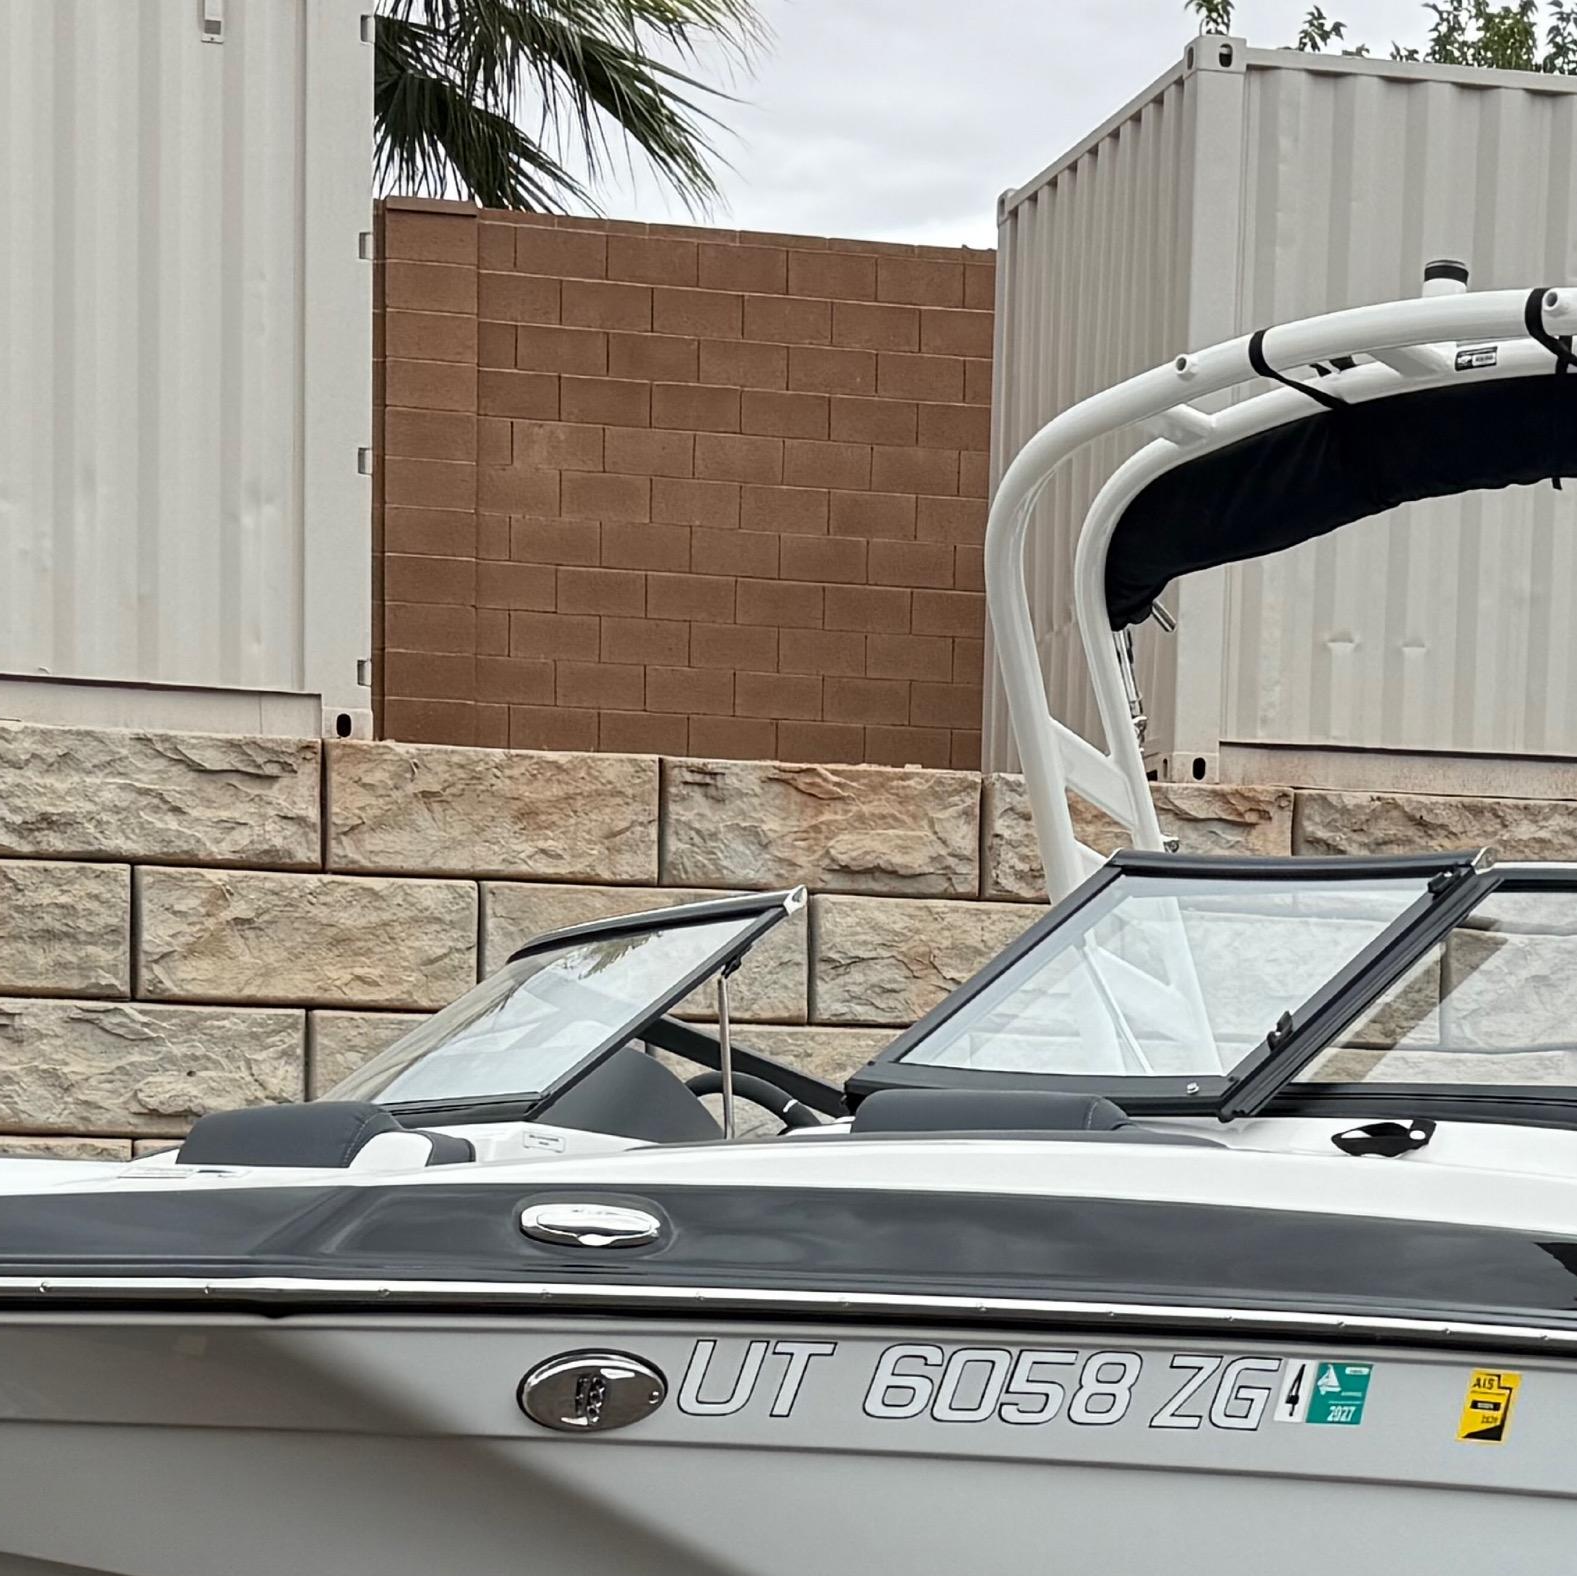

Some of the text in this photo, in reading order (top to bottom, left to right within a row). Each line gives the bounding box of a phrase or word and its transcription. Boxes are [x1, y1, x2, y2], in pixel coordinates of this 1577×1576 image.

[677, 1339, 1283, 1431] UT 6058 ZG
[1326, 1405, 1357, 1422] 2027
